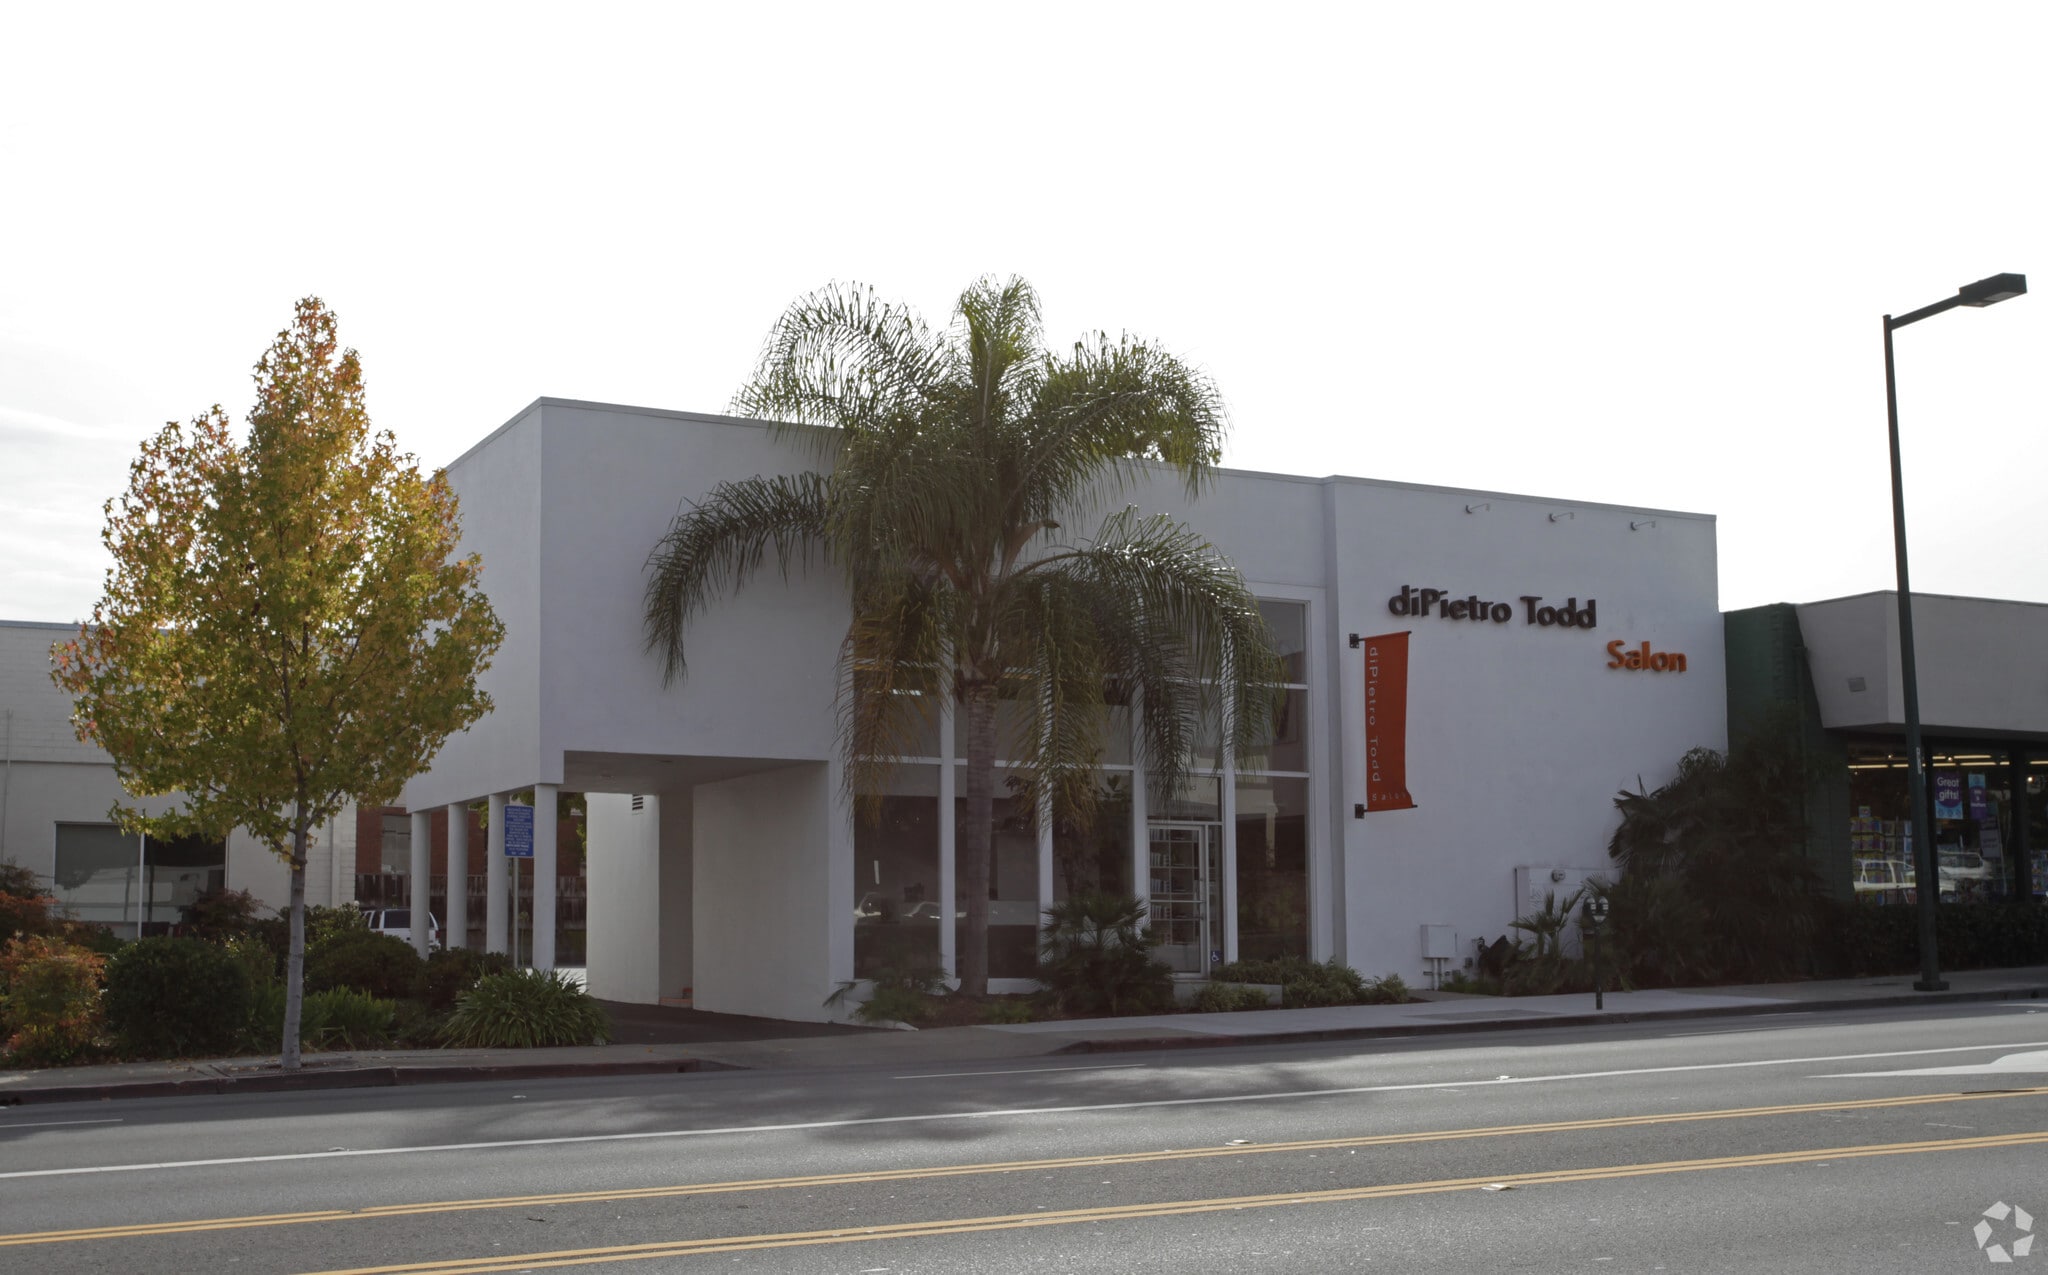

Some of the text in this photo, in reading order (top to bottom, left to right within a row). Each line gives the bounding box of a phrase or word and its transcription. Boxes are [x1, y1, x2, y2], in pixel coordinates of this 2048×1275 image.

[1388, 585, 1597, 629] diPietro Todd
[1606, 640, 1688, 672] Salon
[1369, 647, 1381, 782] diPietro Todd
[1937, 777, 1959, 788] Great
[1939, 790, 1959, 801] gifts!
